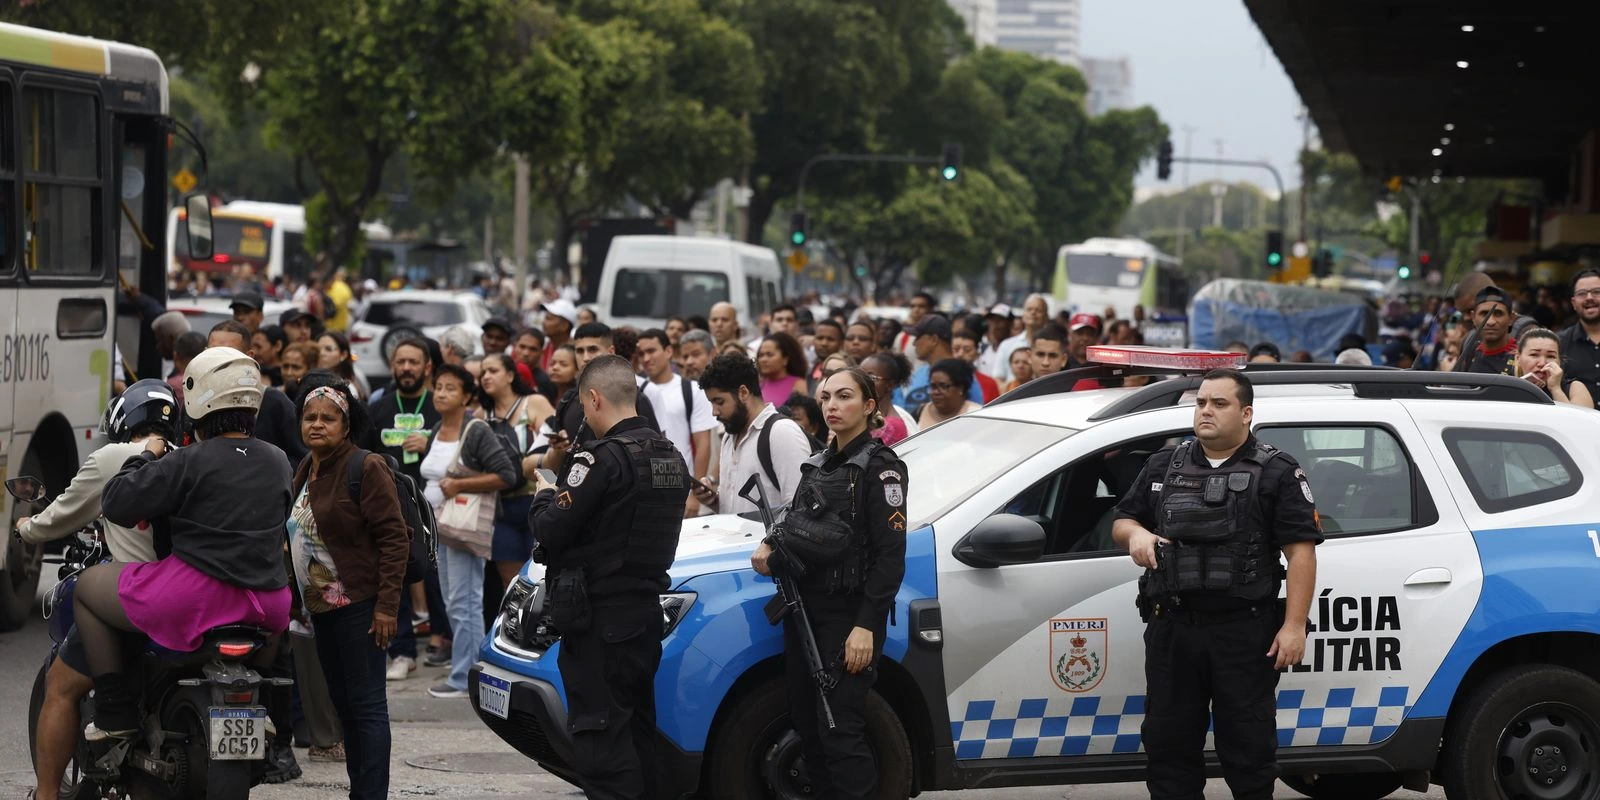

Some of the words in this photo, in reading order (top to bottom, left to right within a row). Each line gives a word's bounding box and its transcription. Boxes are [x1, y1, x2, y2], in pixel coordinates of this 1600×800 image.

[4, 333, 50, 383] B10116
[653, 475, 682, 486] MILITAR
[1307, 588, 1401, 632] ÍCIA
[1053, 621, 1104, 630] PMERJ
[223, 719, 255, 737] SSB
[218, 737, 259, 755] 6C59
